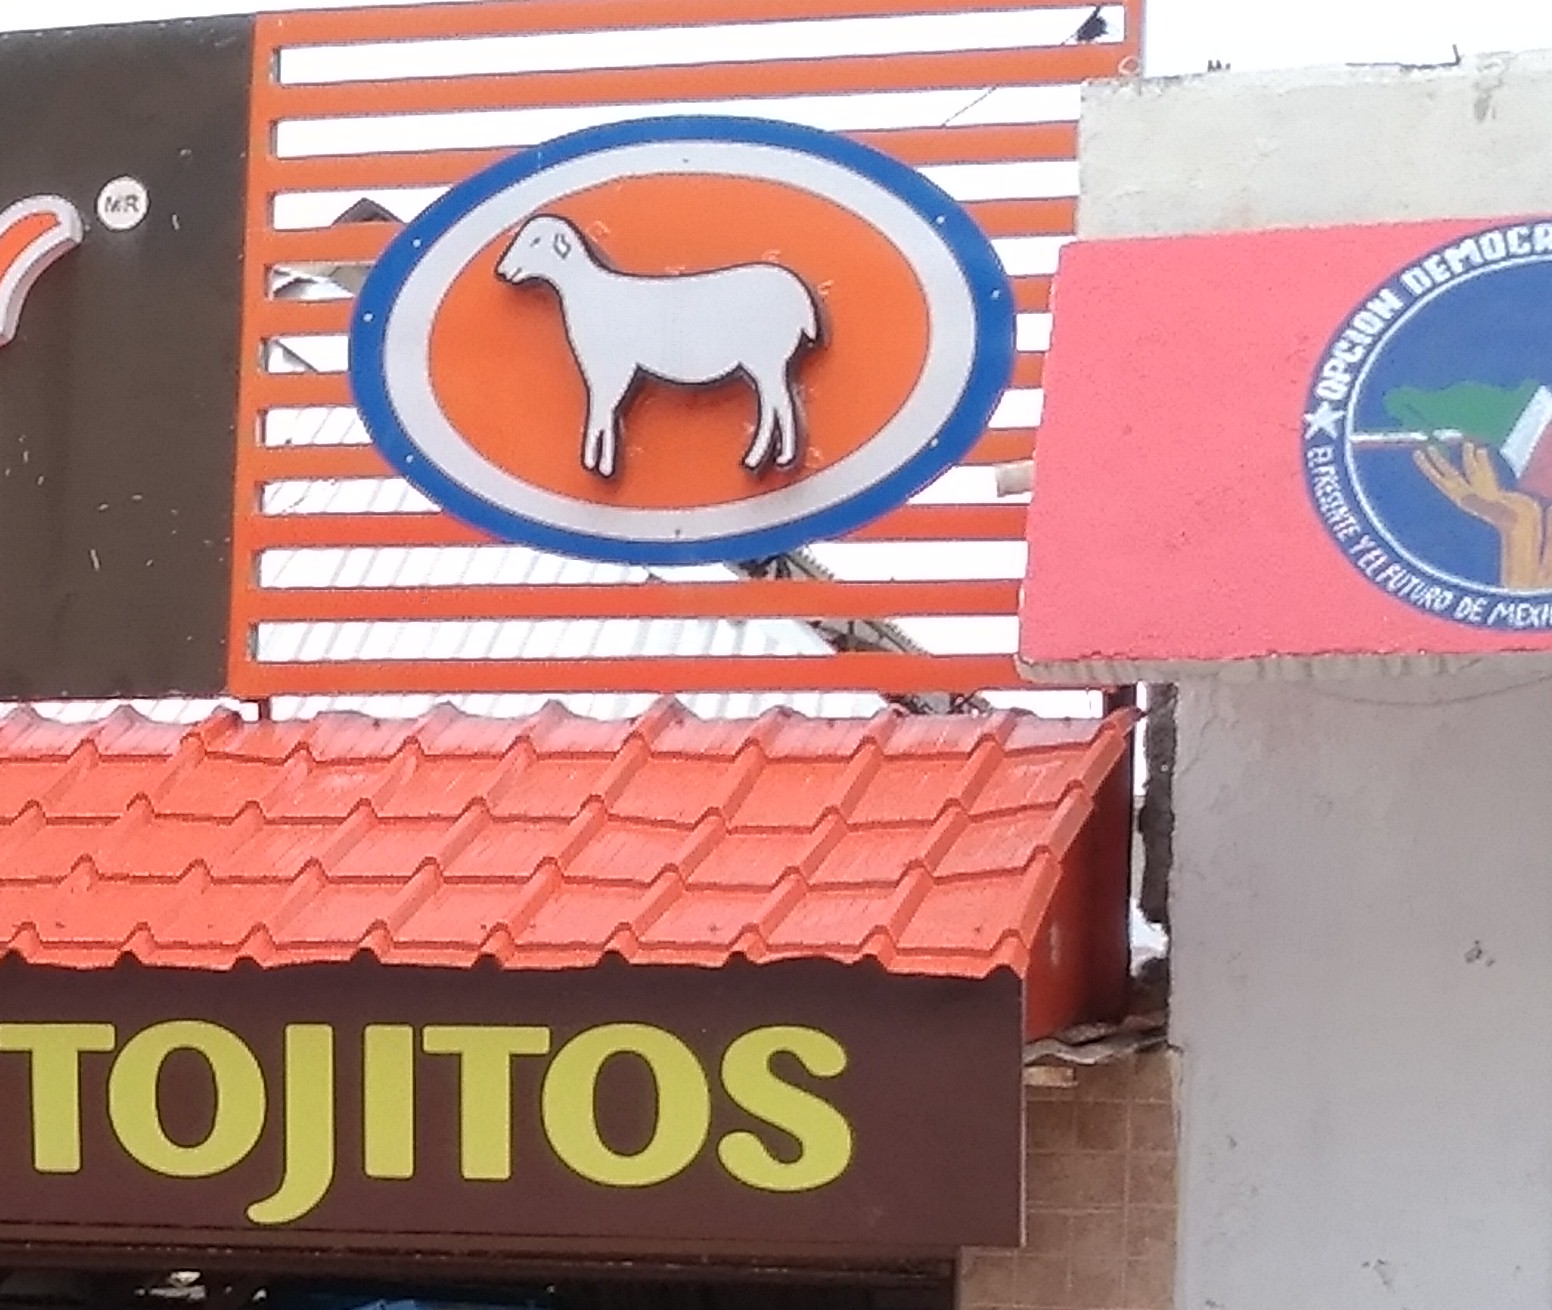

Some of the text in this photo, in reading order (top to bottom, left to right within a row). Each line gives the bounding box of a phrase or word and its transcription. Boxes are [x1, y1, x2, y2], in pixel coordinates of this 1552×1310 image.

[1313, 287, 1405, 402] OPCION
[1348, 534, 1376, 556] Y
[1374, 562, 1454, 613] FUTURO
[1453, 595, 1489, 623] DE
[1486, 601, 1552, 628] MEXI
